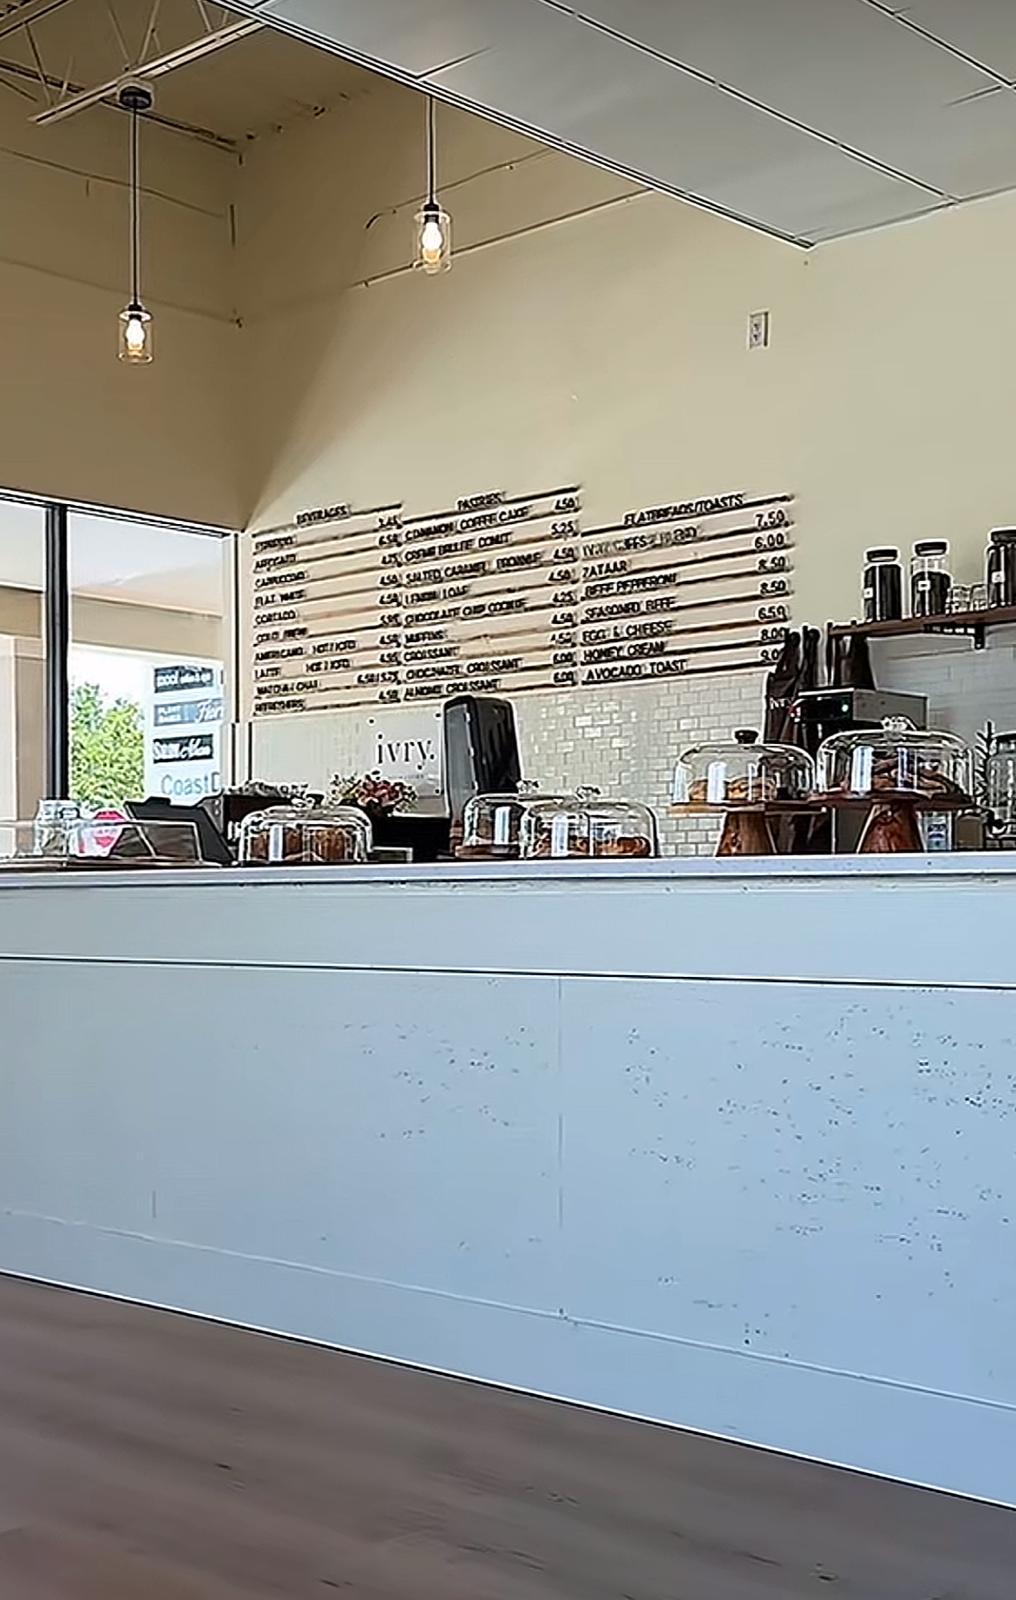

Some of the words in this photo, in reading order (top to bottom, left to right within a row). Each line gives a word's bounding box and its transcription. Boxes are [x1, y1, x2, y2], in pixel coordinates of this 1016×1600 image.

[755, 510, 785, 527] 7.50
[754, 532, 785, 549] 6.00
[650, 658, 688, 674] TOAST
[378, 733, 435, 771] ivry.
